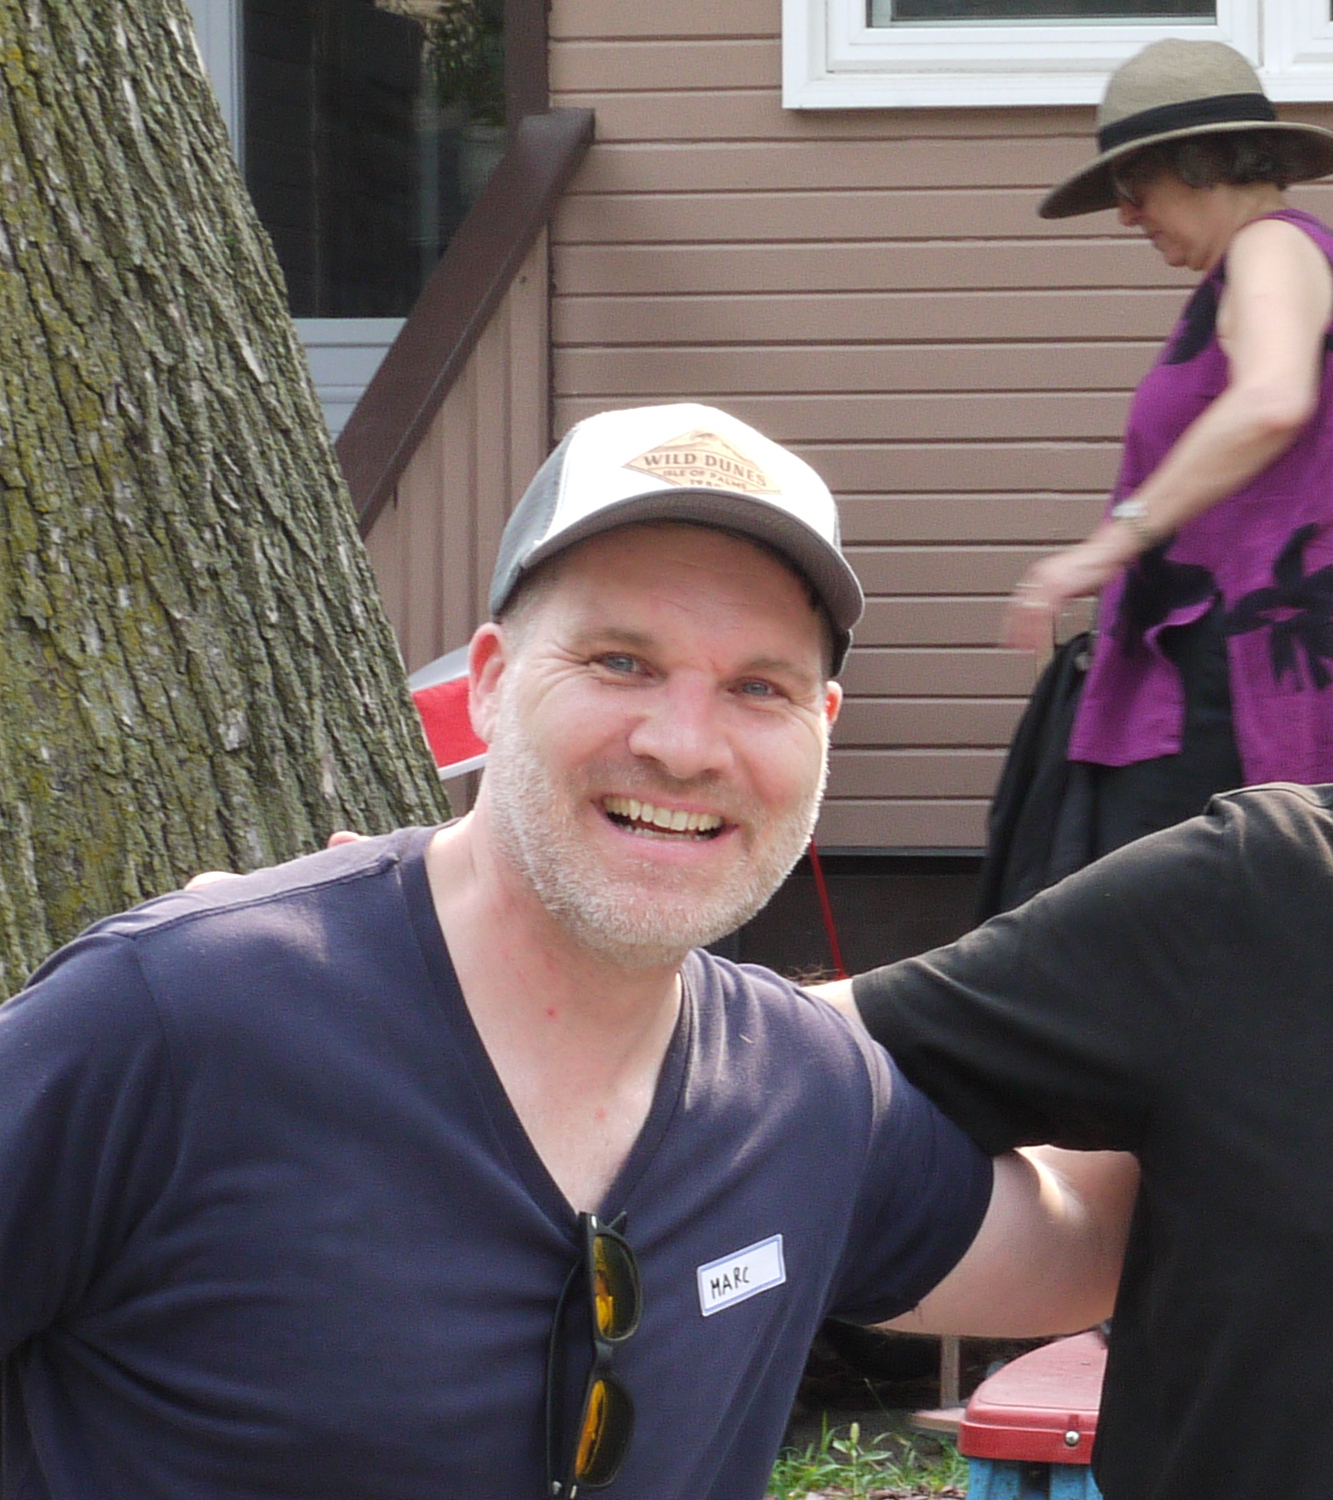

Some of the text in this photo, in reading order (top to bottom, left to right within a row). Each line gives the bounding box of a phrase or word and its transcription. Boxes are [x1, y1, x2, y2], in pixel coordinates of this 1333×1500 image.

[644, 453, 767, 487] WILD DUNES
[662, 469, 686, 477] ISLE
[709, 473, 747, 489] PALMS
[710, 1266, 750, 1299] MARC
